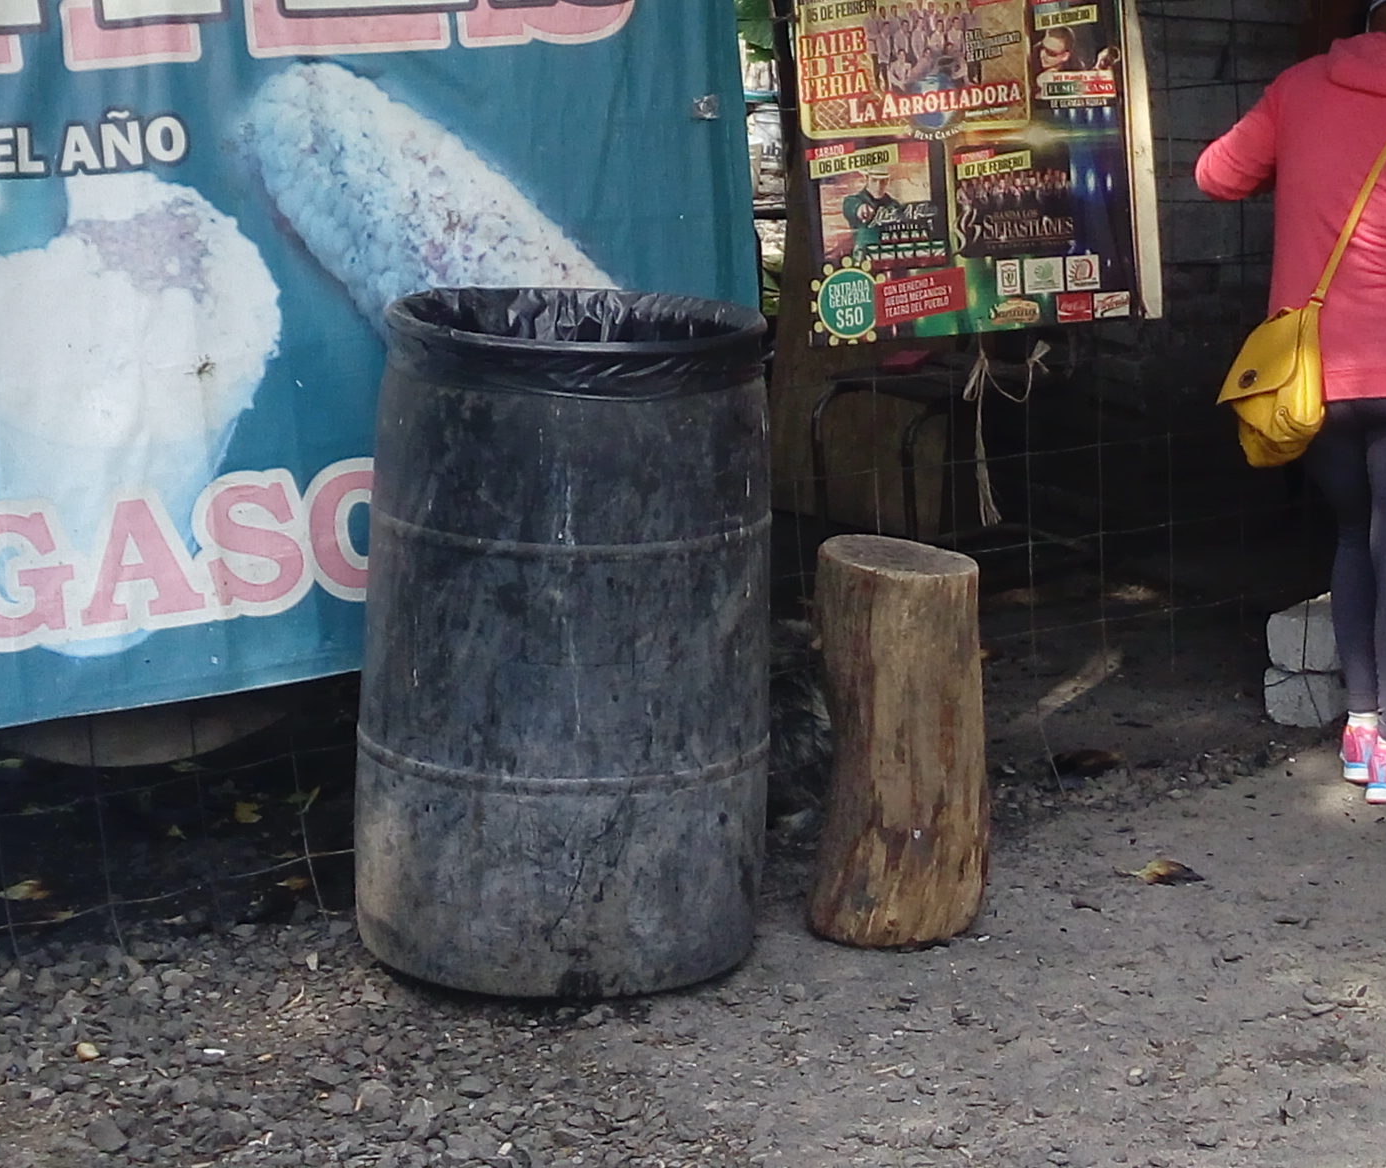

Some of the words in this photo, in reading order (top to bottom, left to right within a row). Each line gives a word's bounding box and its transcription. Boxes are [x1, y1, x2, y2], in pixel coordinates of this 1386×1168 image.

[820, 5, 835, 20] DE
[801, 29, 865, 60] BAILE
[802, 52, 856, 80] DE
[803, 70, 869, 102] FERIA
[848, 96, 876, 124] LA
[880, 82, 1022, 120] ARROLLADORA
[59, 110, 190, 174] AÑO
[814, 144, 845, 158] SABADO
[818, 160, 832, 174] 06
[833, 158, 847, 172] DE
[848, 150, 890, 169] FEBRERO
[964, 164, 975, 176] 07
[977, 163, 987, 174] DE
[988, 155, 1024, 172] FEBRERO
[982, 215, 1074, 240] SEBASTIANES
[828, 279, 870, 299] ENTRADA
[883, 286, 898, 297] CON
[898, 279, 927, 294] DERECHO
[909, 286, 947, 303] MECANICOS
[828, 292, 872, 310] GENERAL
[884, 304, 910, 319] TEATRO
[910, 301, 923, 314] DEL
[923, 295, 950, 312] PUEBLO
[835, 306, 864, 330] $50
